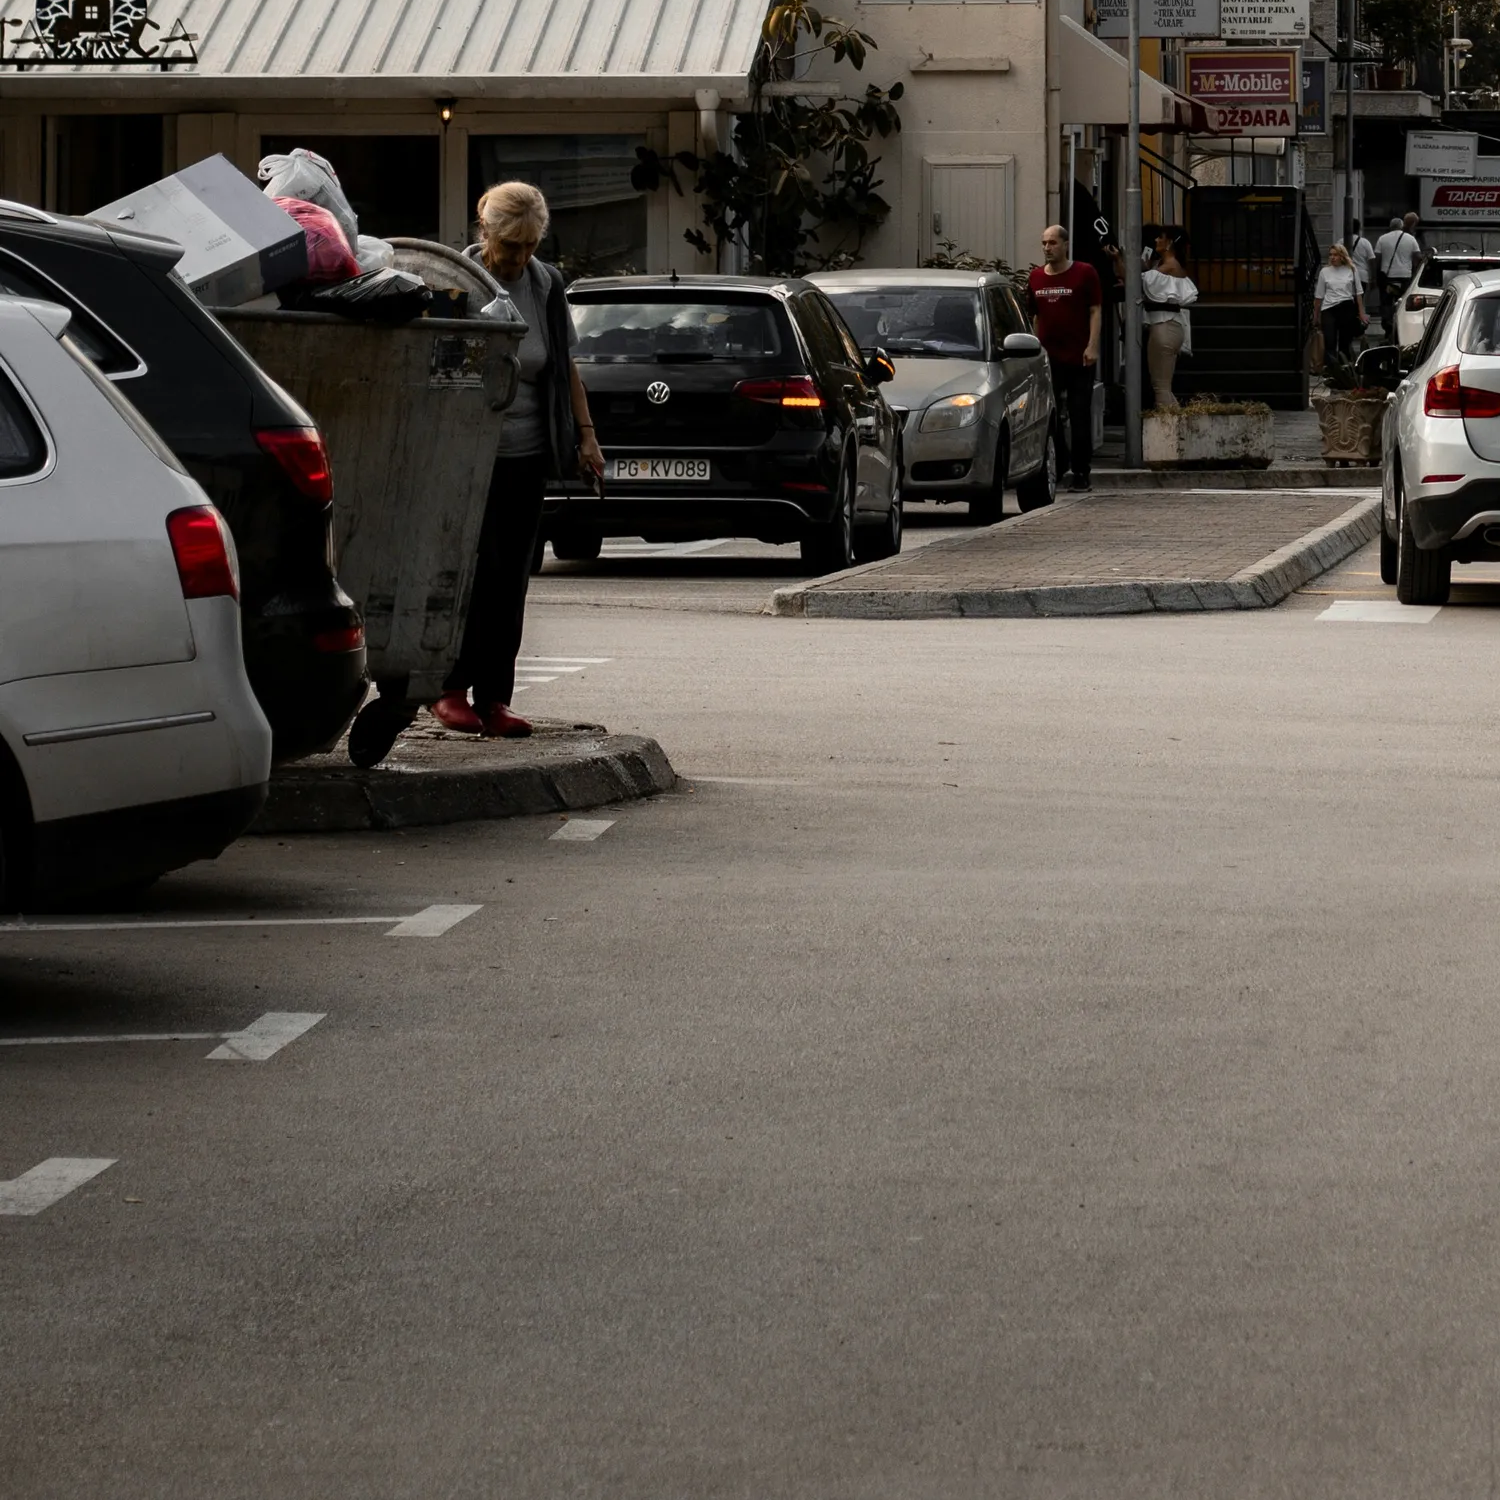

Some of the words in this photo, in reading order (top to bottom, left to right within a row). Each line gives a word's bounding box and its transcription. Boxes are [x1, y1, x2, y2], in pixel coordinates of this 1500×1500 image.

[1221, 6, 1238, 14] ONI
[1247, 6, 1265, 14] PUR
[1268, 6, 1295, 14] PJENA
[1157, 17, 1184, 28] ČARAPE
[1221, 16, 1273, 24] SANITARIJE
[1217, 106, 1291, 127] OŽĐARA
[1437, 208, 1460, 216] BOOK
[1468, 208, 1485, 216] GIFT
[616, 460, 639, 478] PG
